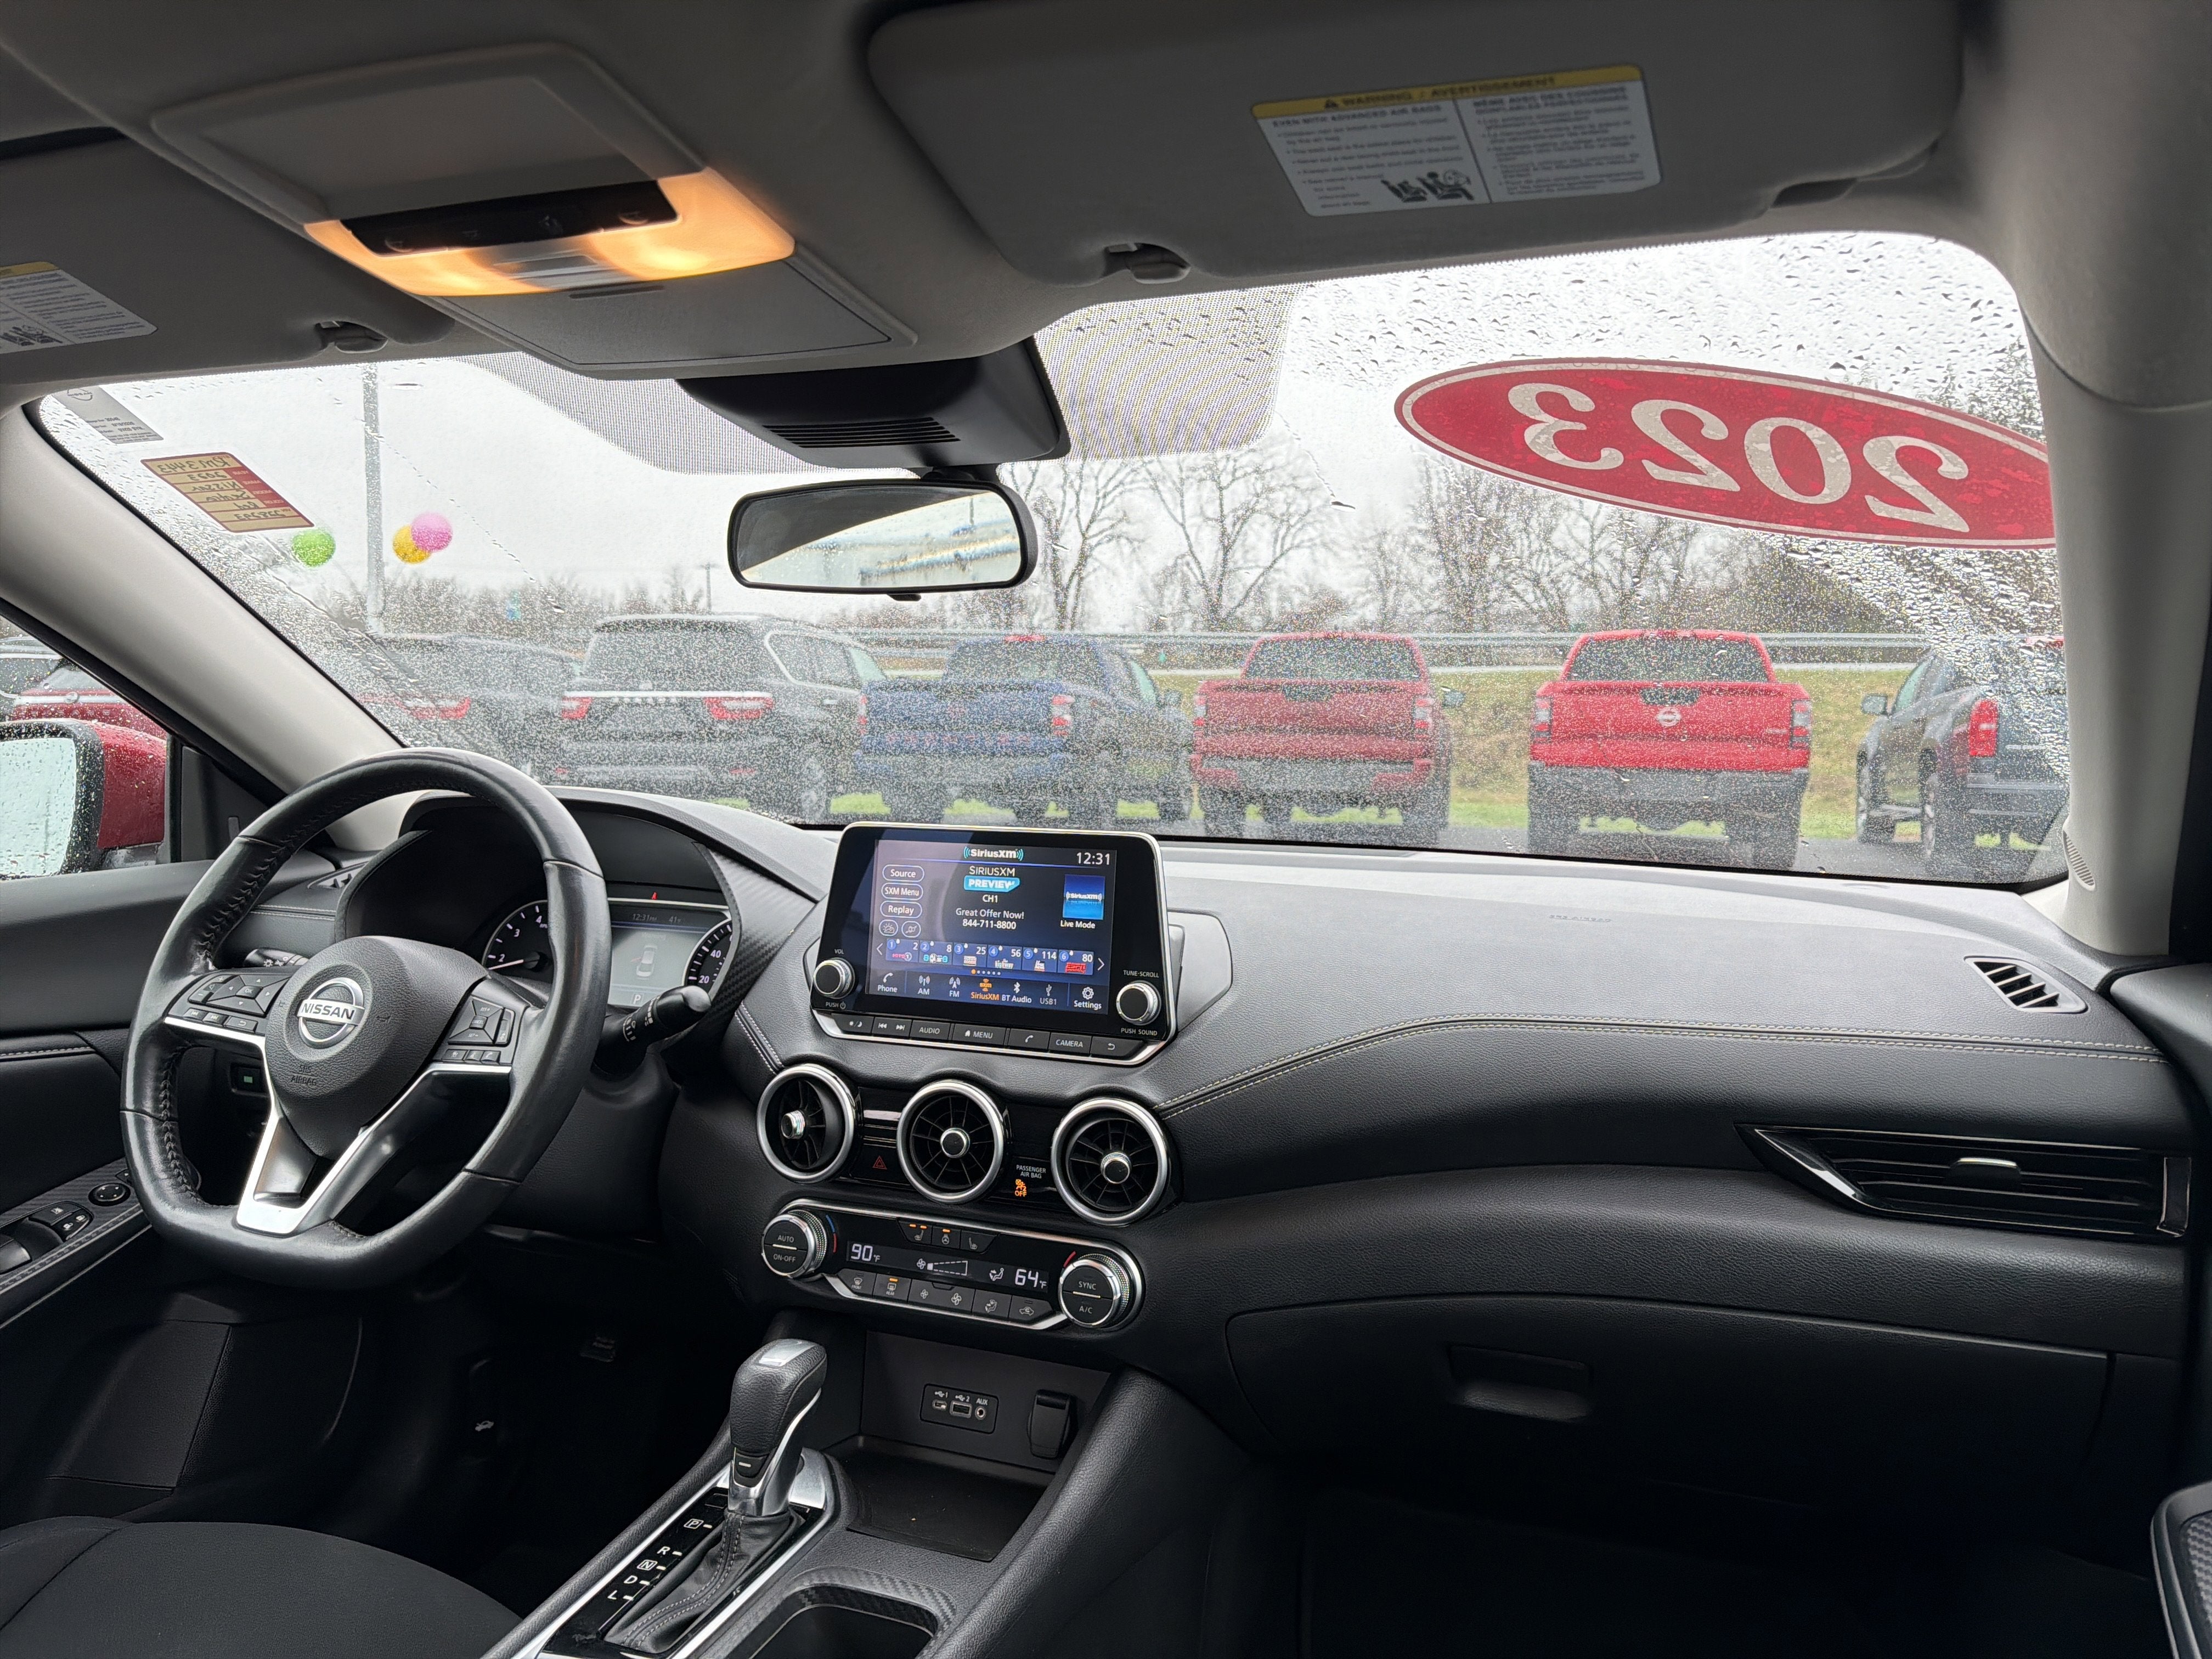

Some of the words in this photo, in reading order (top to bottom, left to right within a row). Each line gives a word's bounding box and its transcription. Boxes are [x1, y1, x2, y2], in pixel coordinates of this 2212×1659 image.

[1076, 852, 1110, 866] 12:31
[890, 869, 916, 878] Source
[969, 866, 1015, 877] SIRIUSXM
[968, 879, 1015, 889] PREVIEW
[885, 887, 900, 895] SXM
[901, 888, 919, 896] Menu
[982, 894, 998, 904] CH1
[888, 905, 915, 916] Replay
[956, 908, 978, 917] Great
[979, 909, 1001, 918] Offer
[1003, 911, 1025, 919] Now!
[535, 916, 543, 924] 4
[962, 918, 1017, 929] 844-711-8800
[1075, 921, 1096, 929] Mode
[514, 928, 520, 938] 3
[946, 945, 952, 953] 8
[976, 947, 986, 955] 25
[1011, 949, 1021, 957] 56
[498, 953, 505, 962] 2
[710, 950, 721, 958] 40
[1042, 951, 1057, 960] 114
[1082, 954, 1093, 962] 80
[698, 975, 709, 984] 20
[878, 985, 898, 993] Phone
[633, 994, 641, 1005] P
[970, 992, 1000, 1001] SiriusXM
[1012, 995, 1032, 1003] Audio
[1040, 997, 1057, 1006] USB1
[1074, 1000, 1102, 1011] Settings
[302, 1003, 356, 1020] NISSAN
[919, 1026, 940, 1035] AUDIO
[973, 1031, 994, 1039] MENU
[1056, 1039, 1084, 1048] CAMERA
[1016, 1165, 1046, 1173] PASSENGER
[1079, 1280, 1097, 1290] SYNC
[1079, 1305, 1093, 1314] A/C
[657, 1546, 670, 1555] R
[624, 1575, 638, 1584] D
[607, 1590, 618, 1600] L
